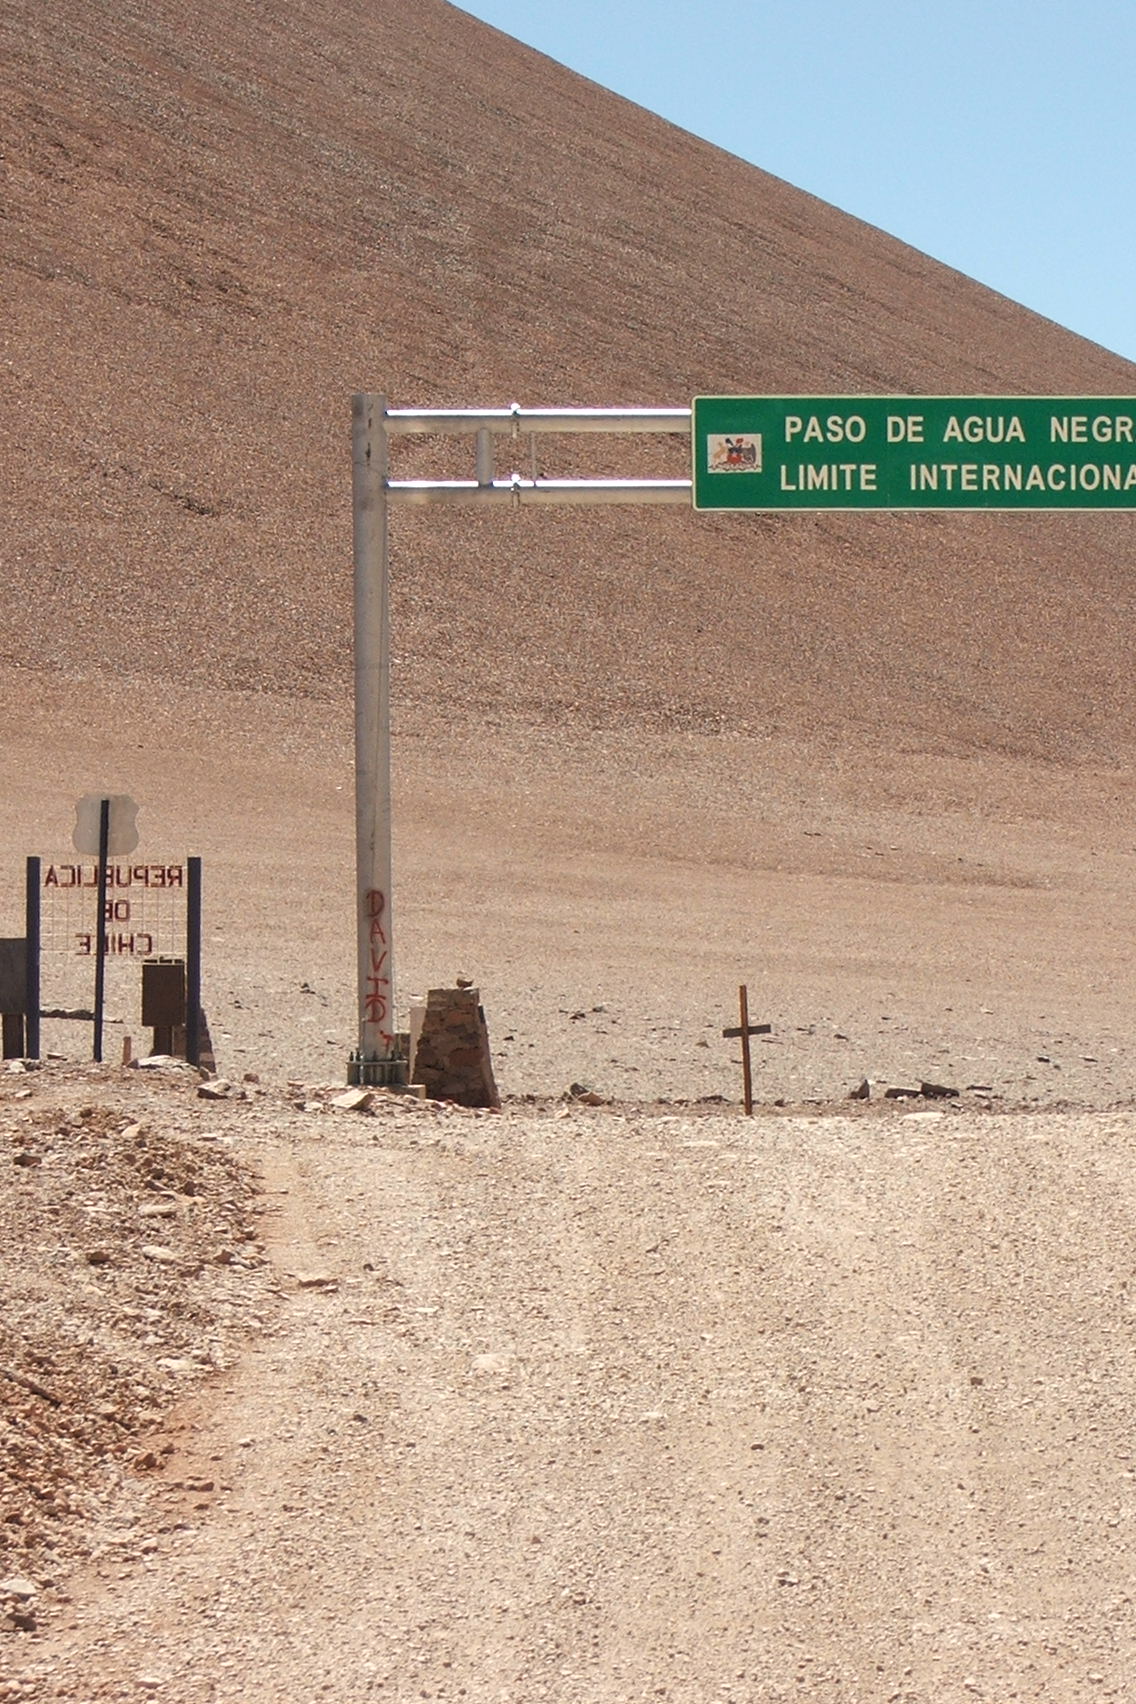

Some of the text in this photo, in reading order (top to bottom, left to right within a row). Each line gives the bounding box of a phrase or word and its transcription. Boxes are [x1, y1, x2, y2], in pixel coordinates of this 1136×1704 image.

[785, 415, 867, 442] PASO
[886, 416, 924, 442] DE
[943, 415, 1025, 442] AGUA
[780, 464, 877, 490] LIMITE
